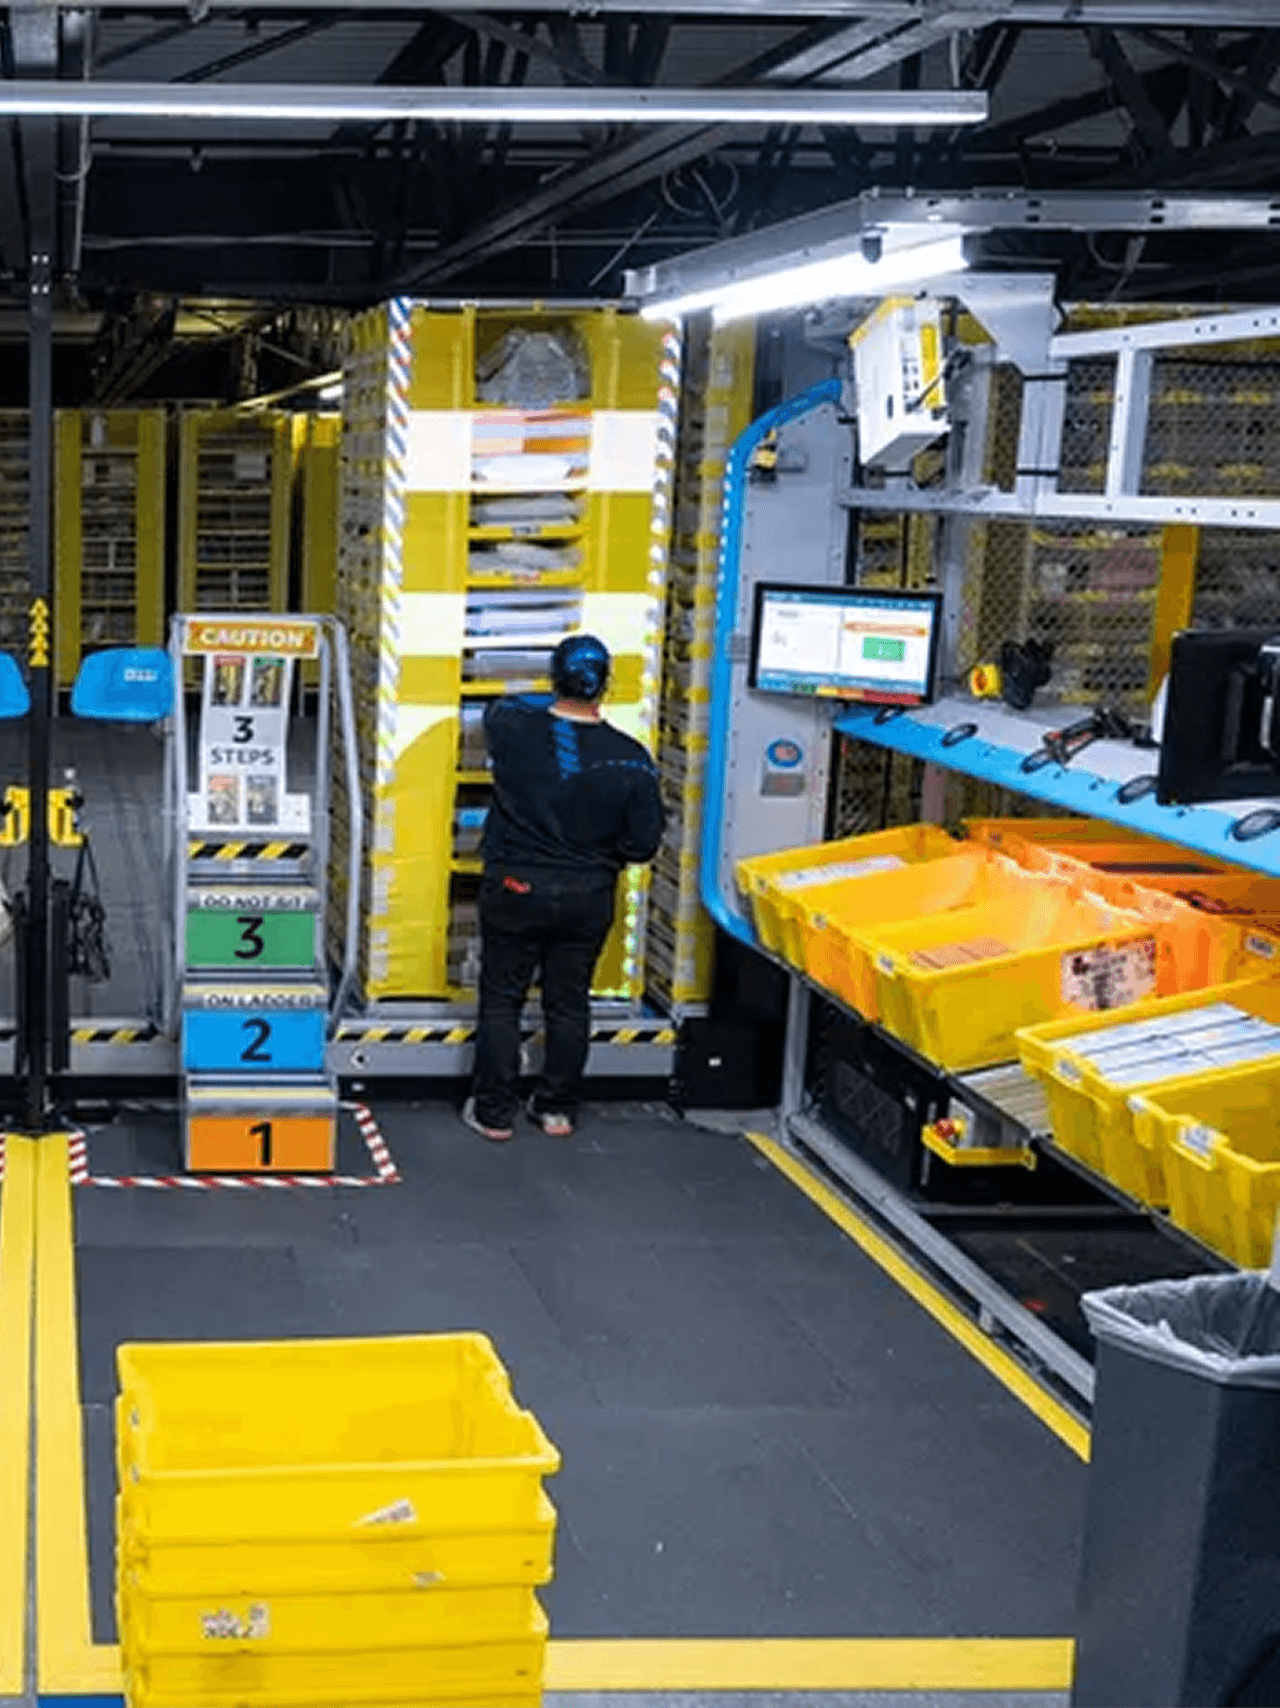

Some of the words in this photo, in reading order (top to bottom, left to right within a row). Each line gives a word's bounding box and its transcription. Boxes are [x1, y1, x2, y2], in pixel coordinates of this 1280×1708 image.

[199, 627, 305, 648] CAUTION
[233, 715, 255, 743] 3
[210, 749, 275, 765] STEPS
[204, 896, 231, 907] DO
[235, 896, 269, 907] NOT
[234, 916, 264, 960] 3
[240, 1017, 272, 1062] 2
[249, 1121, 273, 1166] 1
